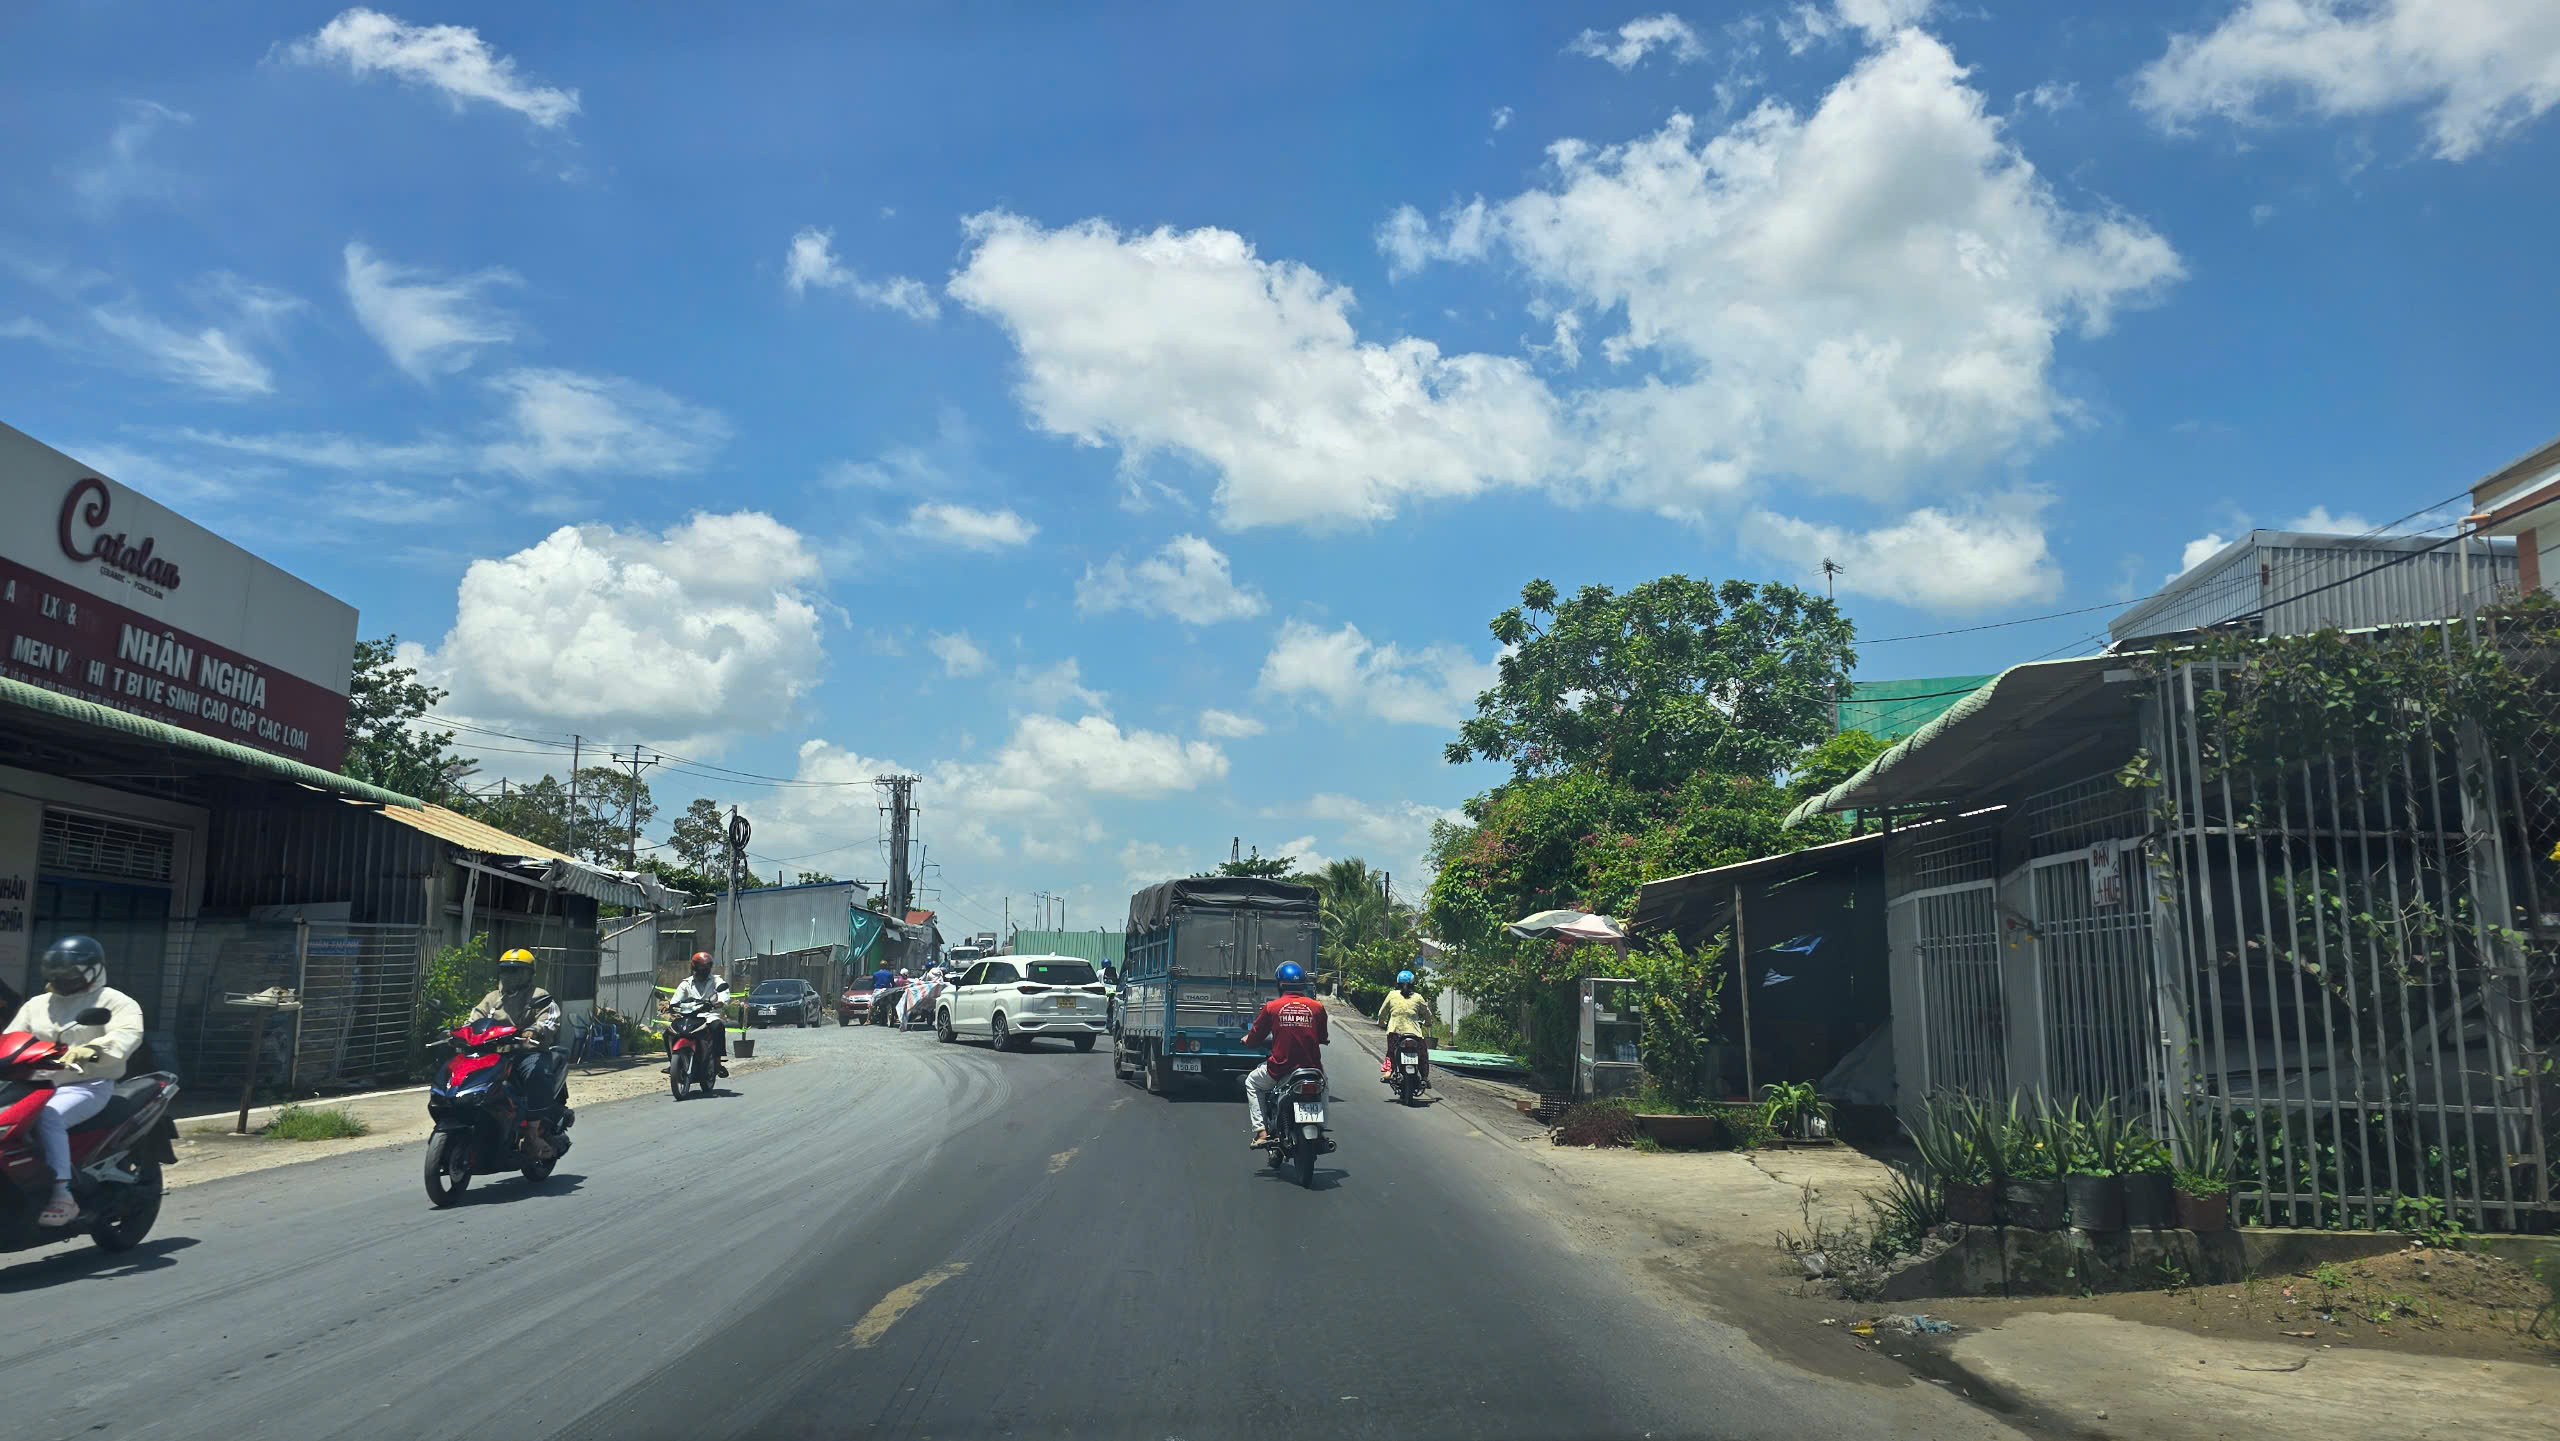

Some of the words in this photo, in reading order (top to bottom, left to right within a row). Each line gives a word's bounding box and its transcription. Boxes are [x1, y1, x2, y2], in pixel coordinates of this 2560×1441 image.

[59, 478, 181, 589] Catalan
[12, 634, 54, 670] MEN
[166, 685, 201, 715] SINH
[201, 696, 229, 723] CAO
[118, 623, 194, 681] NHÂN
[199, 653, 266, 709] NGHĨA
